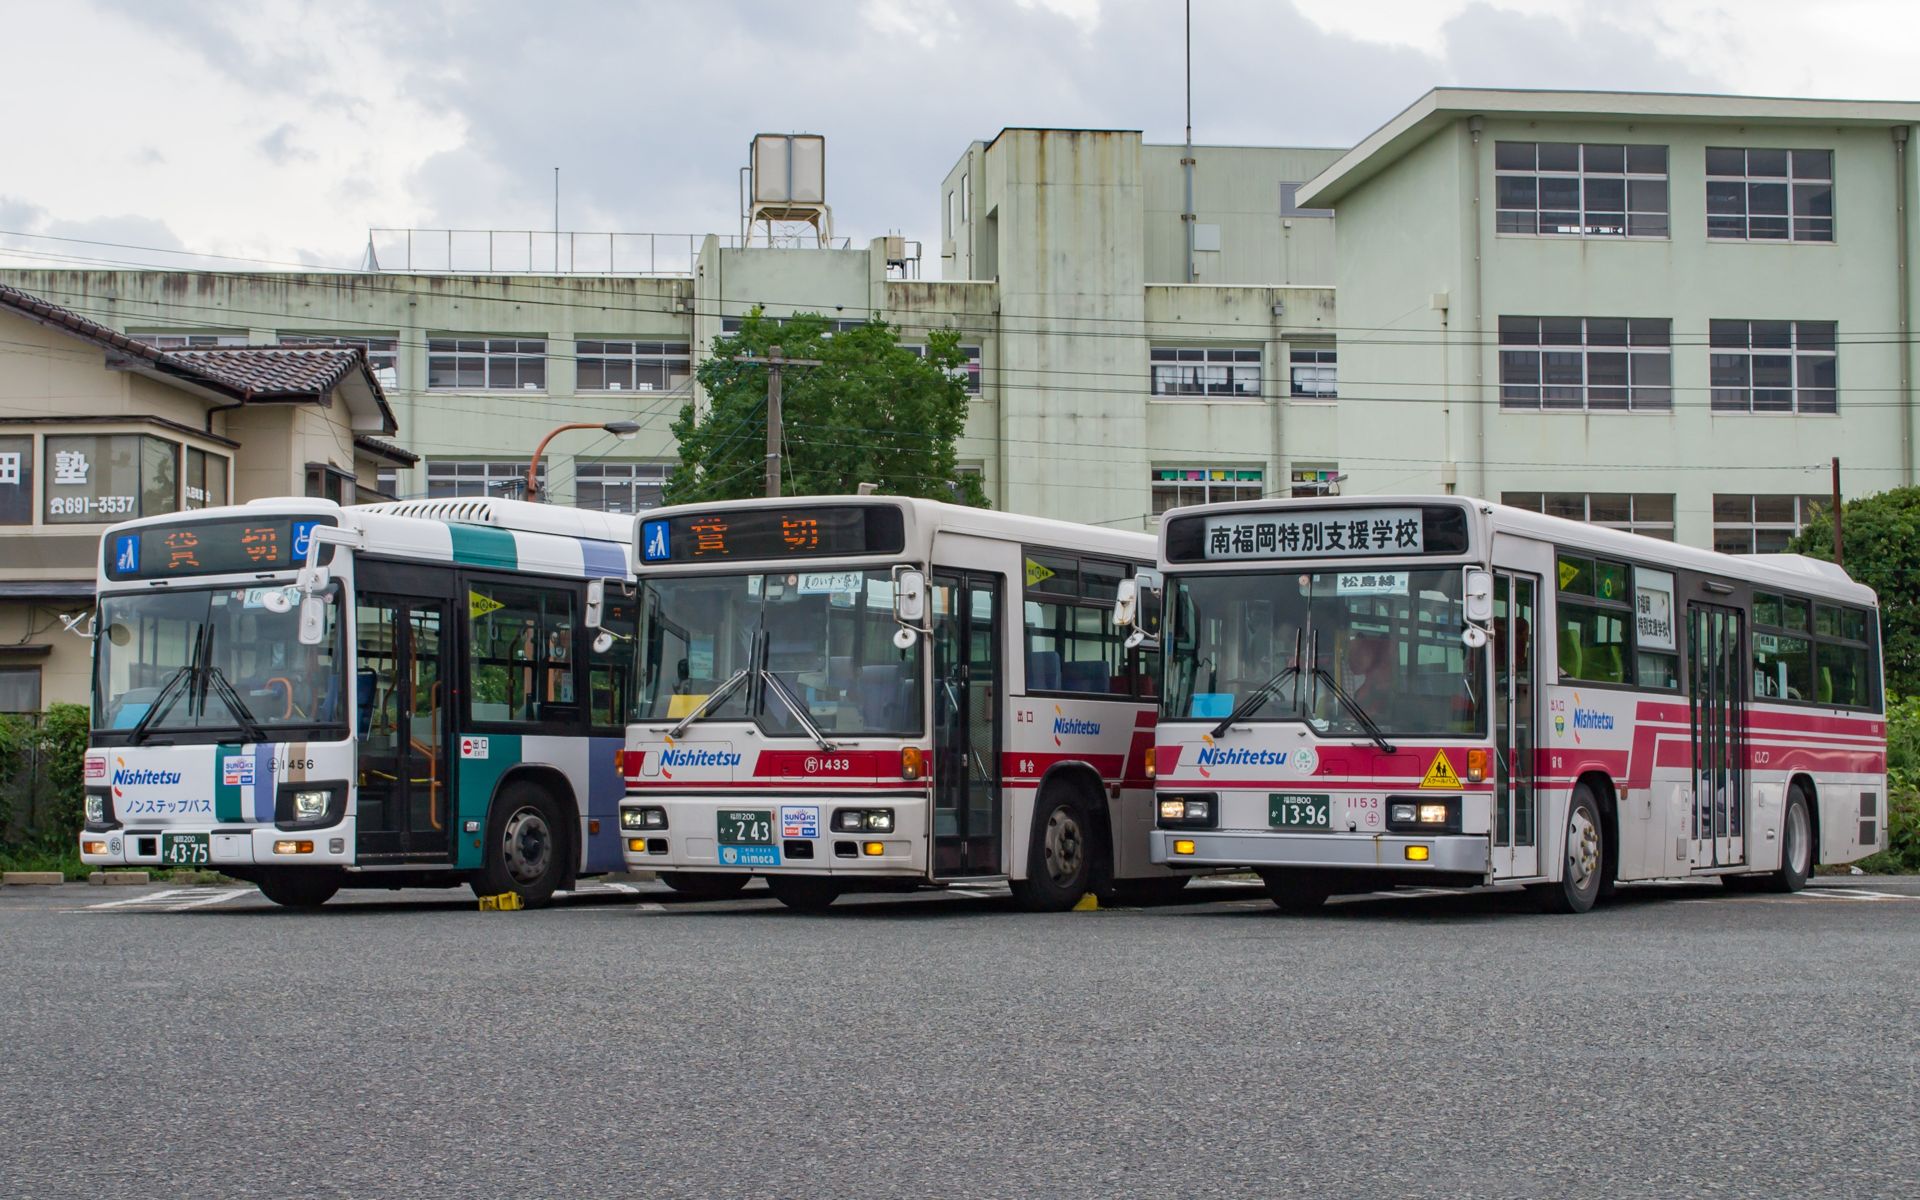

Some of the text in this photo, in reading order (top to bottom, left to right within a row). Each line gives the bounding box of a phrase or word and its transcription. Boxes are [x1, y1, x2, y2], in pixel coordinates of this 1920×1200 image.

[55, 450, 90, 484] 塾
[65, 496, 135, 514] 691-3537
[1210, 518, 1419, 554] 南福岡特別支援学校
[1342, 575, 1395, 588] 松島線
[1054, 717, 1101, 735] Nishitetsu
[1573, 708, 1614, 730] Nishitetsu
[660, 749, 742, 767] Nishitetsu
[819, 759, 850, 771] 1433
[1197, 747, 1287, 765] Nishitetsu
[113, 769, 182, 785] Nishitetsu
[126, 800, 212, 813] ノンステップバス
[1347, 798, 1378, 808] 1153
[741, 853, 775, 864] nimoca
